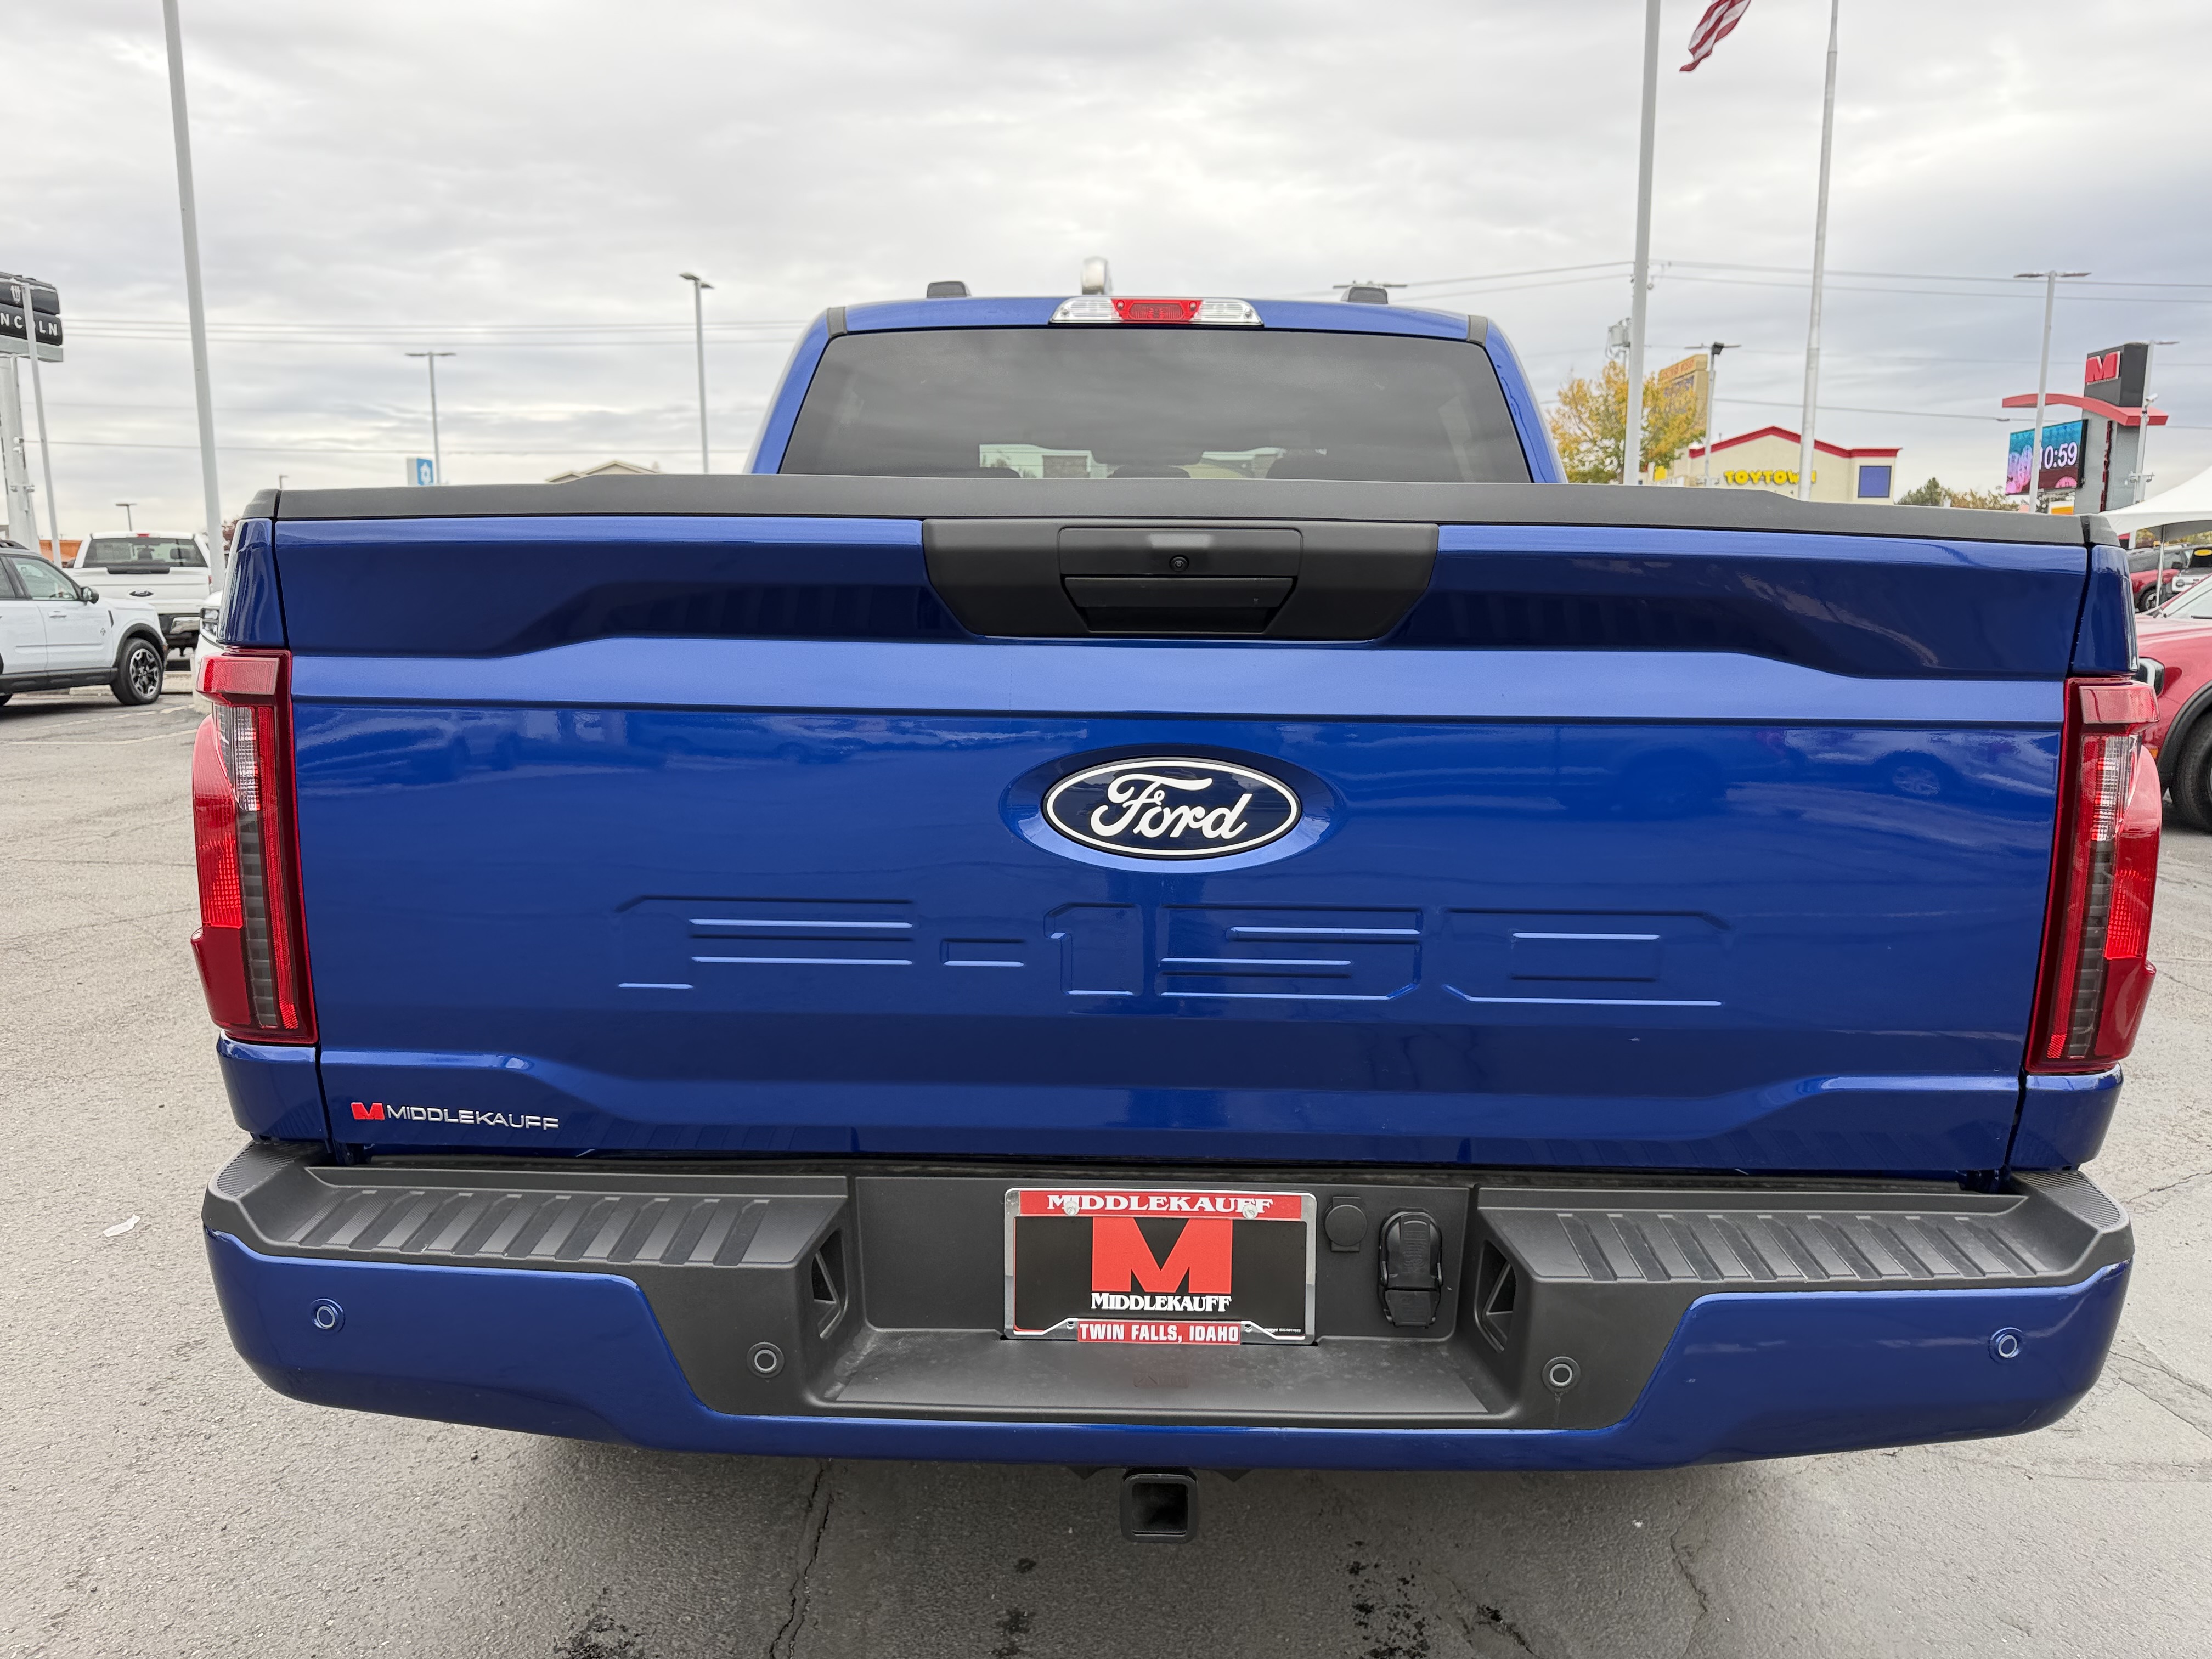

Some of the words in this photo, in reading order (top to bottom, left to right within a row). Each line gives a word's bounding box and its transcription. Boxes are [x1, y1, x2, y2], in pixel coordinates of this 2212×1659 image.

[2085, 351, 2121, 383] M
[1091, 774, 1252, 839] Ford
[614, 894, 1732, 1006] F-150
[387, 1105, 559, 1130] MIDDLEKAUFF
[1092, 1217, 1233, 1294] M
[1091, 1293, 1232, 1312] MIDDLEKAUFF
[1080, 1323, 1124, 1340] TWIN
[1131, 1324, 1182, 1343] FALLS,
[1189, 1325, 1238, 1341] IDAHO
